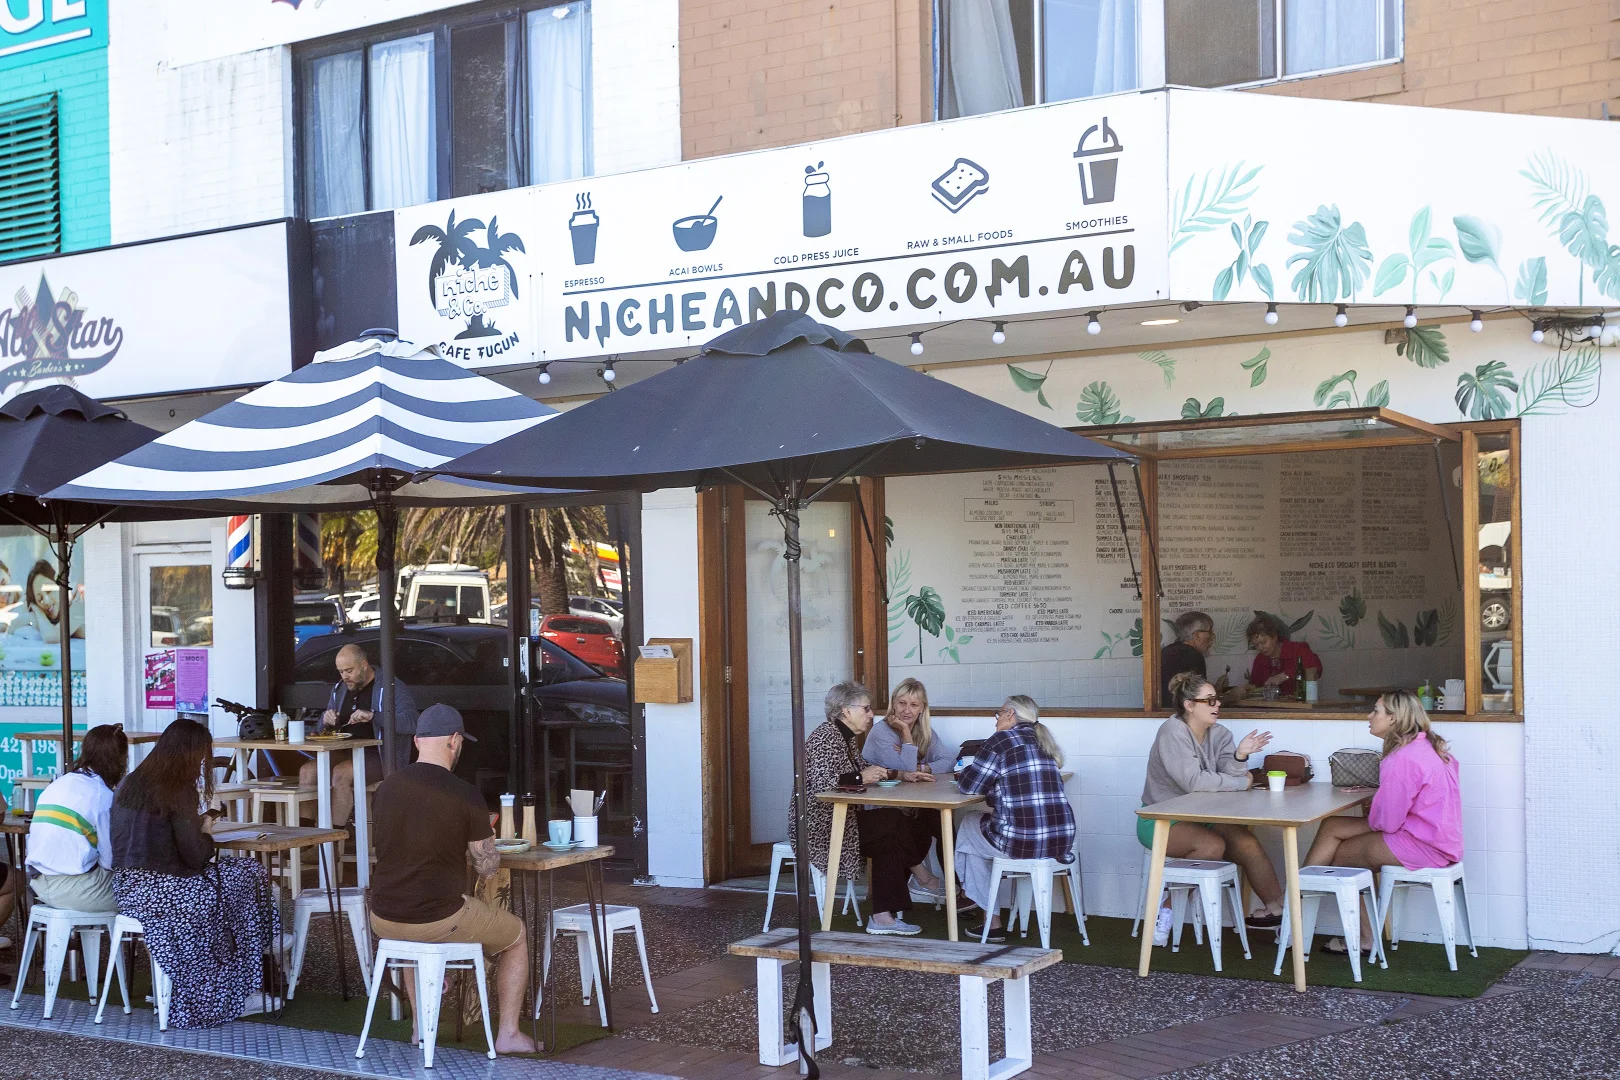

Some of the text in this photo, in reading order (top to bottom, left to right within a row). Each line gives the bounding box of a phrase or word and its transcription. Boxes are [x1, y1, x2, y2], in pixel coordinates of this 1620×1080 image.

[1065, 215, 1129, 231] SMOOTHIES
[907, 229, 1013, 250] RAW & SMALL FOODS
[774, 248, 860, 265] COLD PRESS JUICE
[669, 263, 724, 276] ACAI BOWLS
[564, 276, 606, 288] ESPRESSO
[565, 244, 1135, 349] NICHEANDCO.COM.AU
[448, 297, 461, 319] &
[45, 301, 123, 353] Star
[439, 331, 520, 360] CAFE TUGUN
[0, 765, 24, 783] Ope
